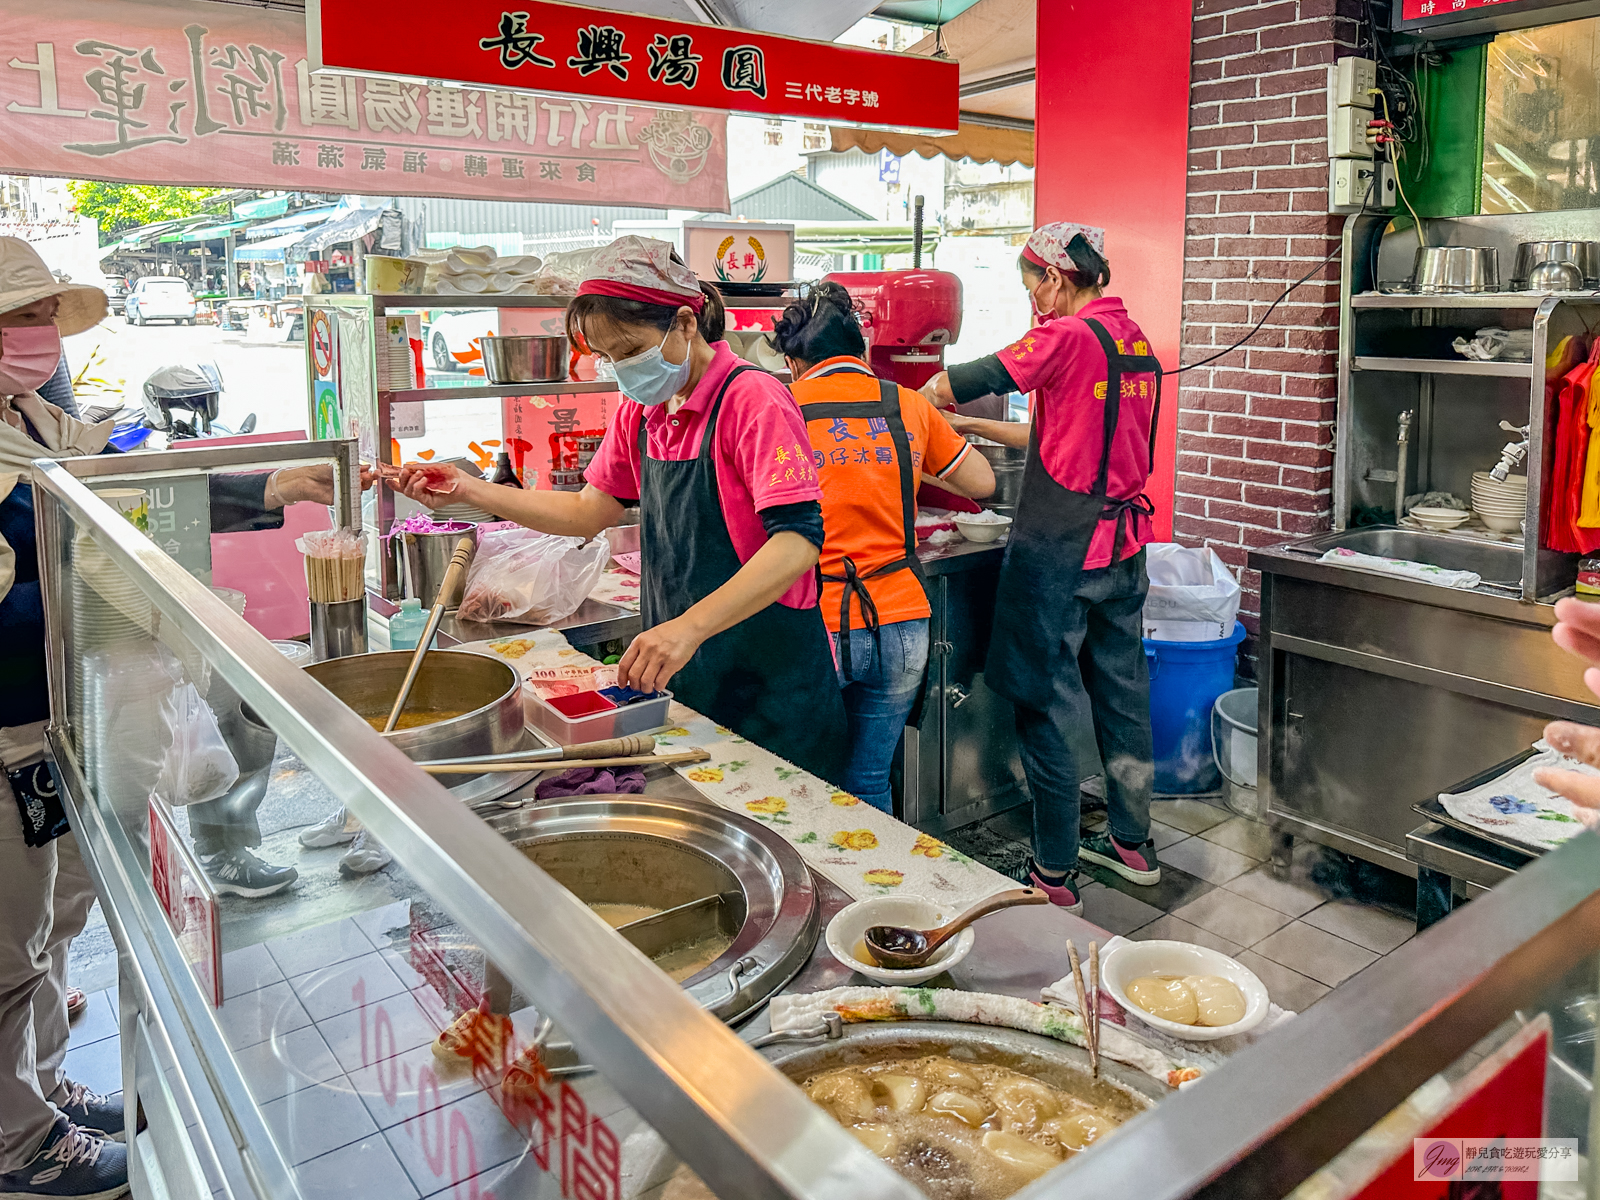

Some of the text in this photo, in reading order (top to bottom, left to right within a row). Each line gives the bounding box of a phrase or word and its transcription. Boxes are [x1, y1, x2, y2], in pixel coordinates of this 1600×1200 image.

[480, 11, 767, 100] 長興湯圓
[785, 81, 880, 108] 三代老字號
[726, 251, 756, 270] 長興
